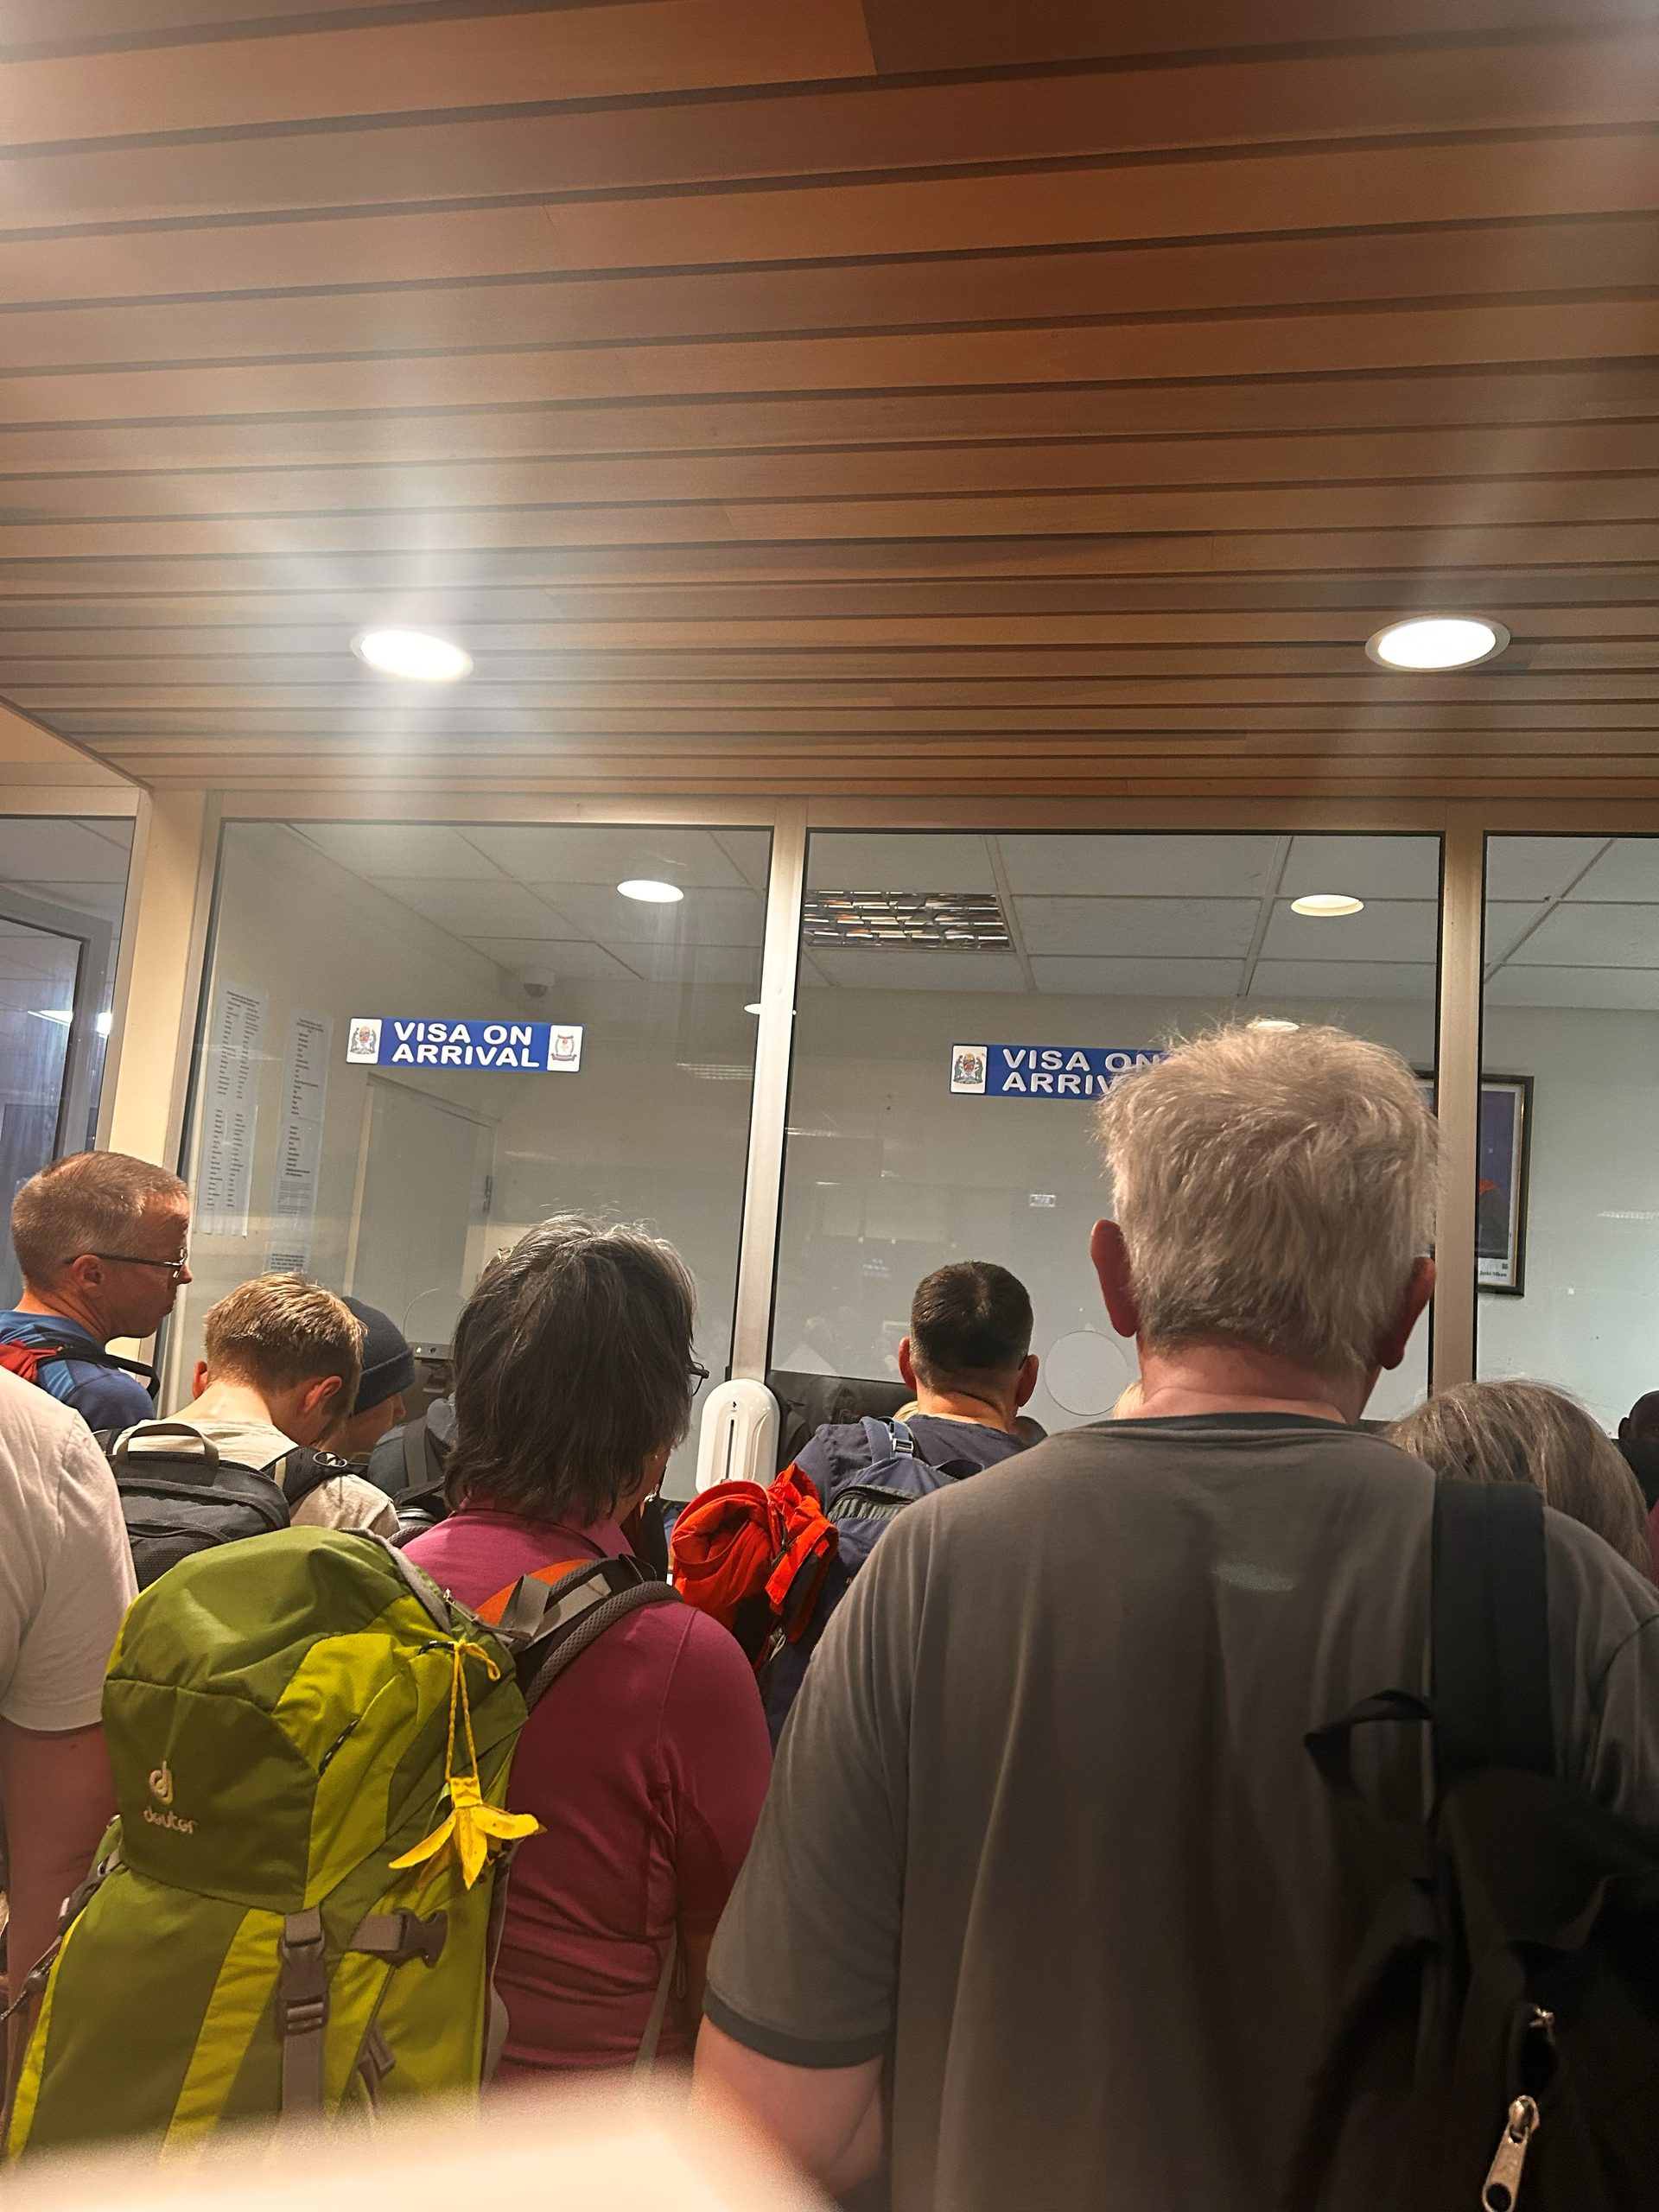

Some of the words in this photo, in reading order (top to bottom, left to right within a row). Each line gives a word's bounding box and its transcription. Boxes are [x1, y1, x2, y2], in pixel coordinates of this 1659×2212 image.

[393, 1021, 472, 1044] VISA
[482, 1025, 533, 1046] ON
[391, 1043, 540, 1068] ARRIVAL
[1001, 1048, 1090, 1071] VISA
[1001, 1071, 1118, 1096] ARRIV
